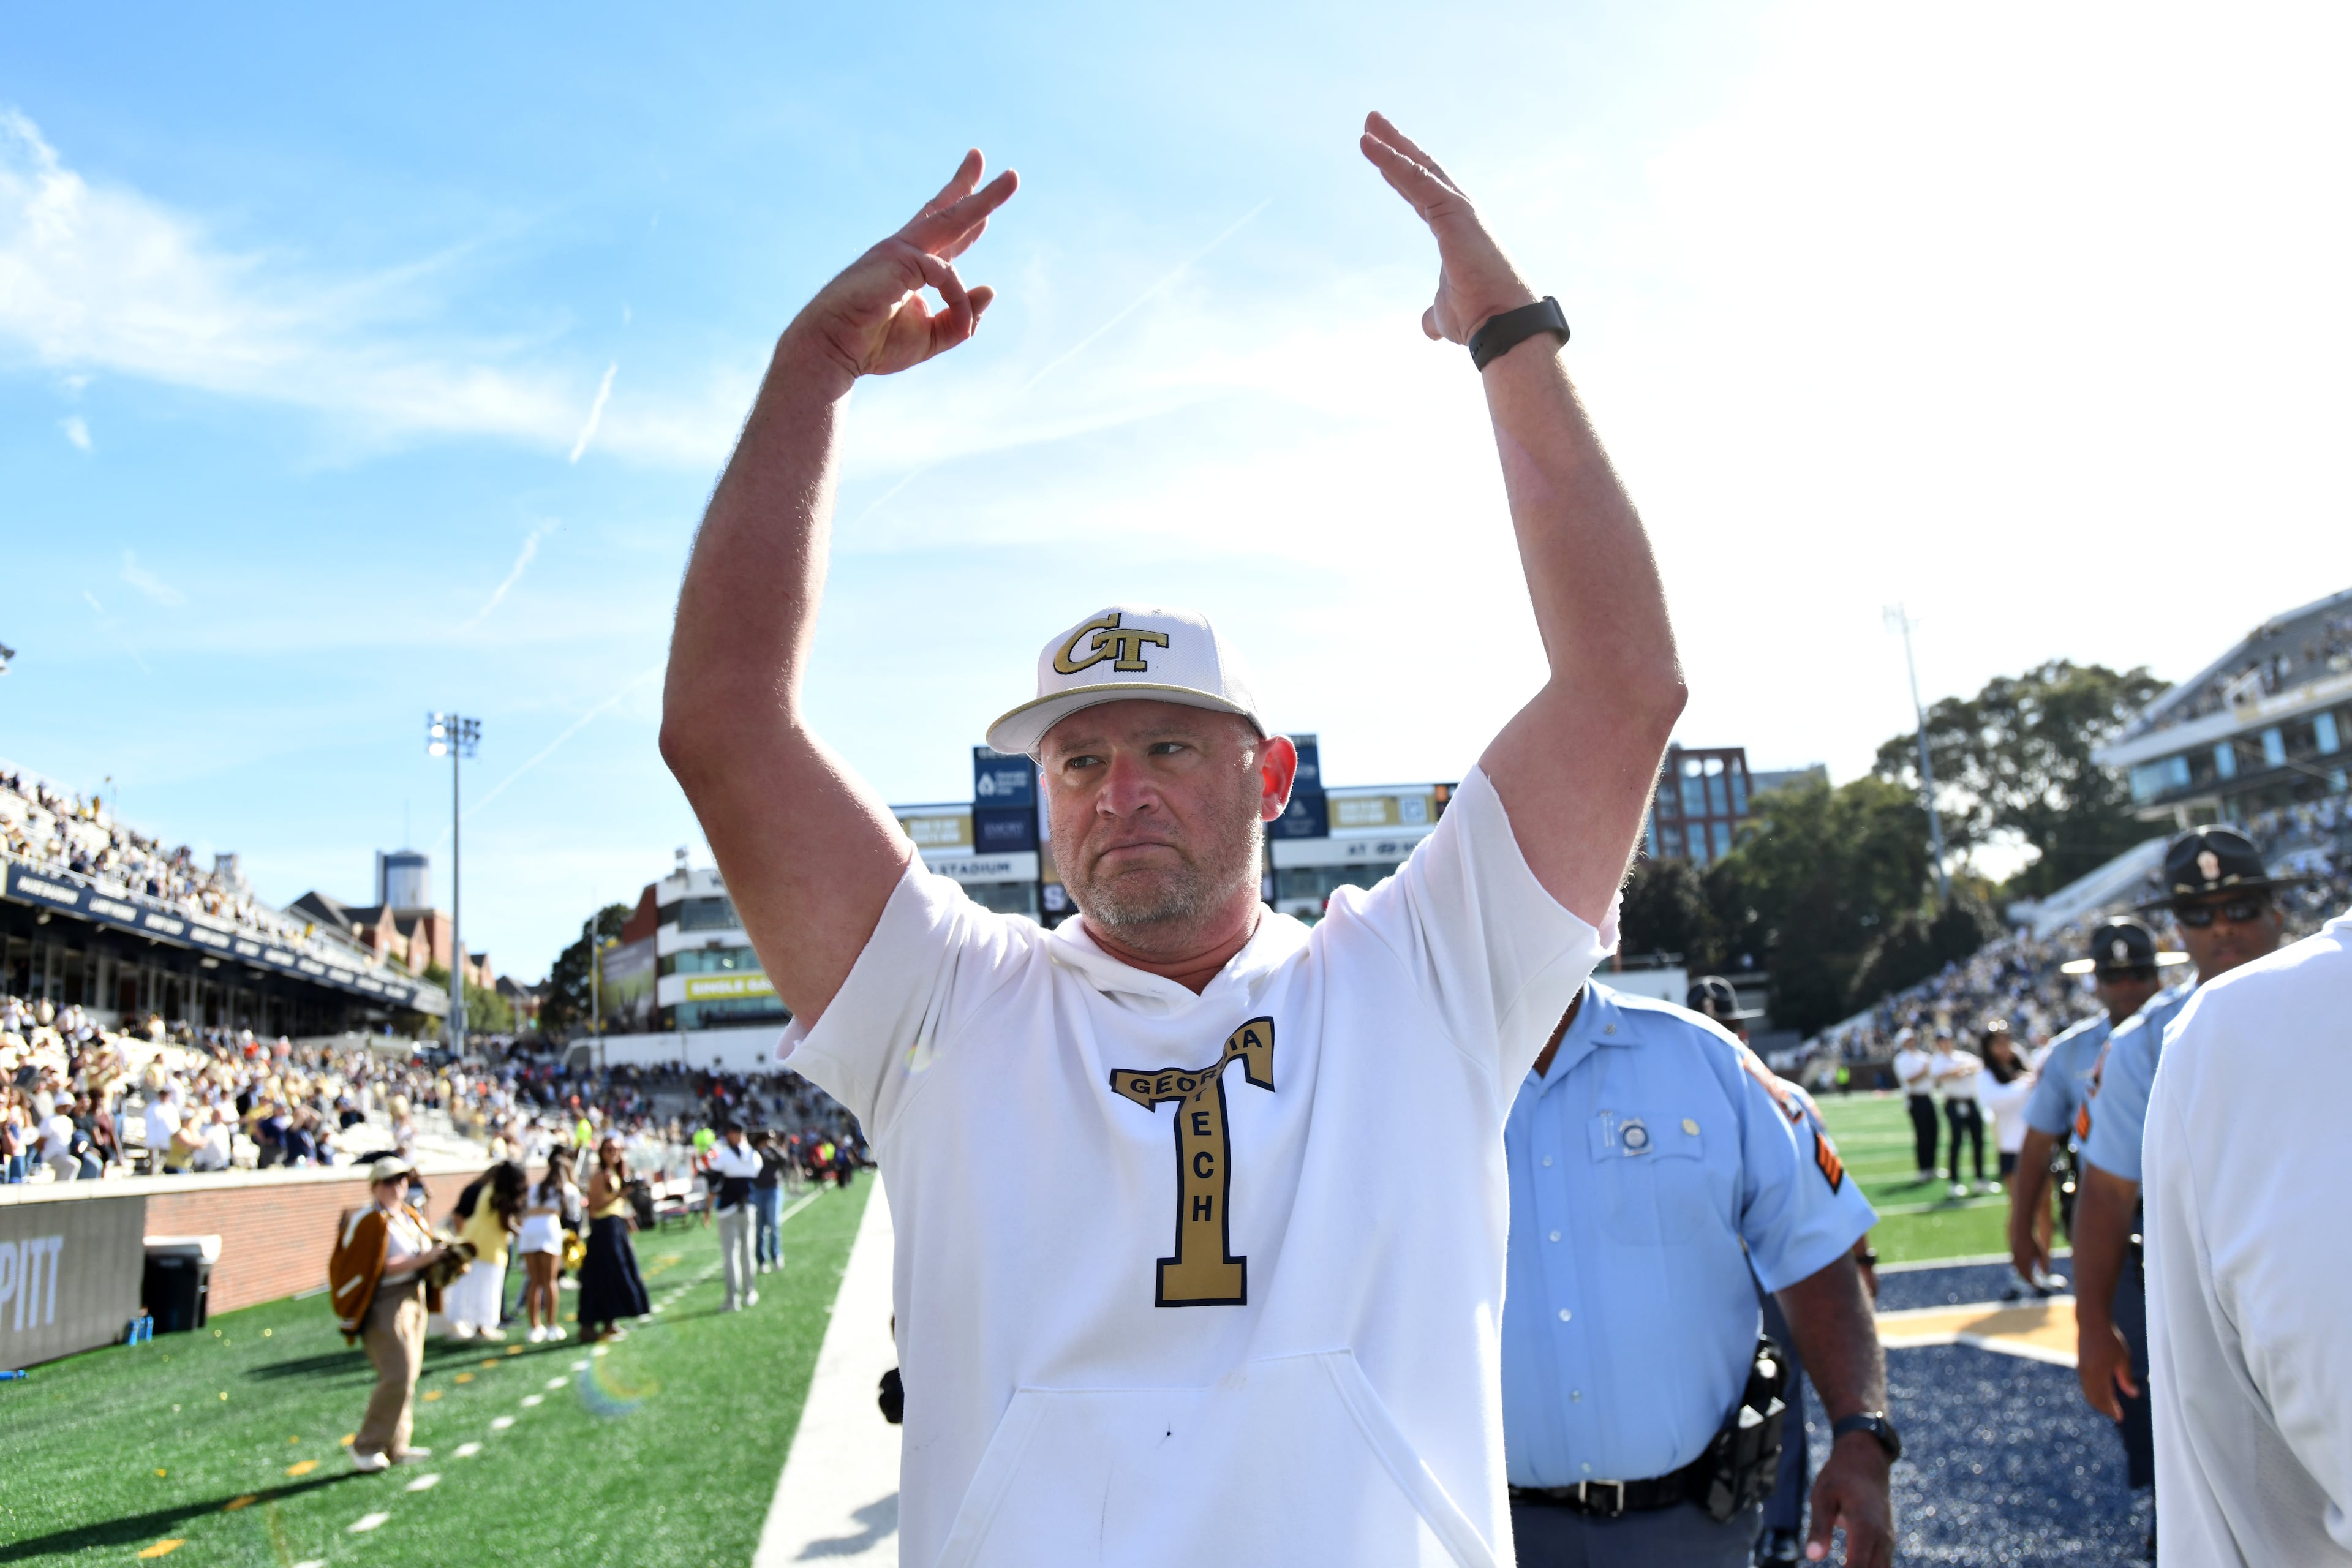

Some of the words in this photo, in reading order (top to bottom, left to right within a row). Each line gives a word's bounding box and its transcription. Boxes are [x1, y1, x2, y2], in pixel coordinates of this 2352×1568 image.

[1054, 612, 1169, 674] GT
[939, 861, 1010, 875] STADIUM
[691, 979, 744, 996] SINGLE
[1130, 1029, 1263, 1095] GEORIA
[1191, 1088, 1215, 1221] TECH
[0, 1235, 64, 1332] PITT
